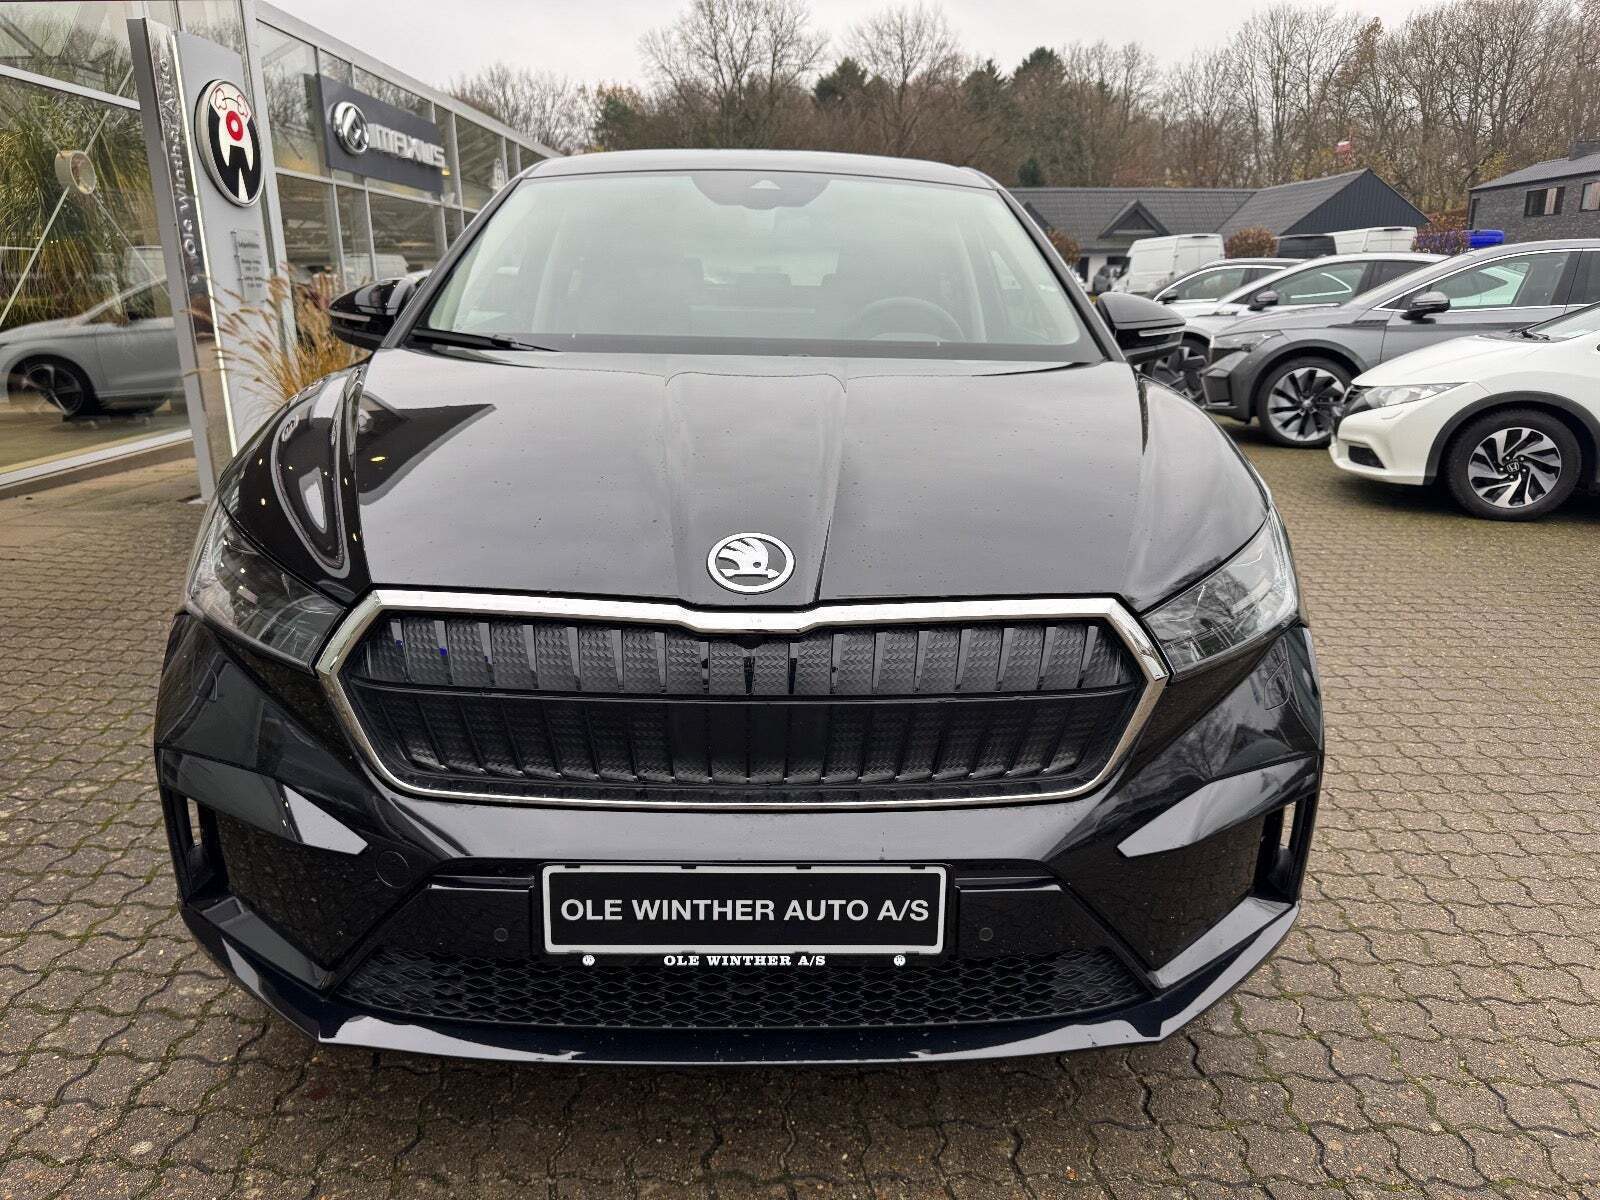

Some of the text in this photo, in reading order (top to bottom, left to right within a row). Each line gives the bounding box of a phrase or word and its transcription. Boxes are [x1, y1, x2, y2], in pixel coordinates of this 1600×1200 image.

[367, 122, 446, 168] MAXUS
[182, 218, 198, 257] Ole
[560, 898, 929, 921] OLE WINTHER AUTO A/S
[663, 955, 826, 967] OLE WINTHER A/S
